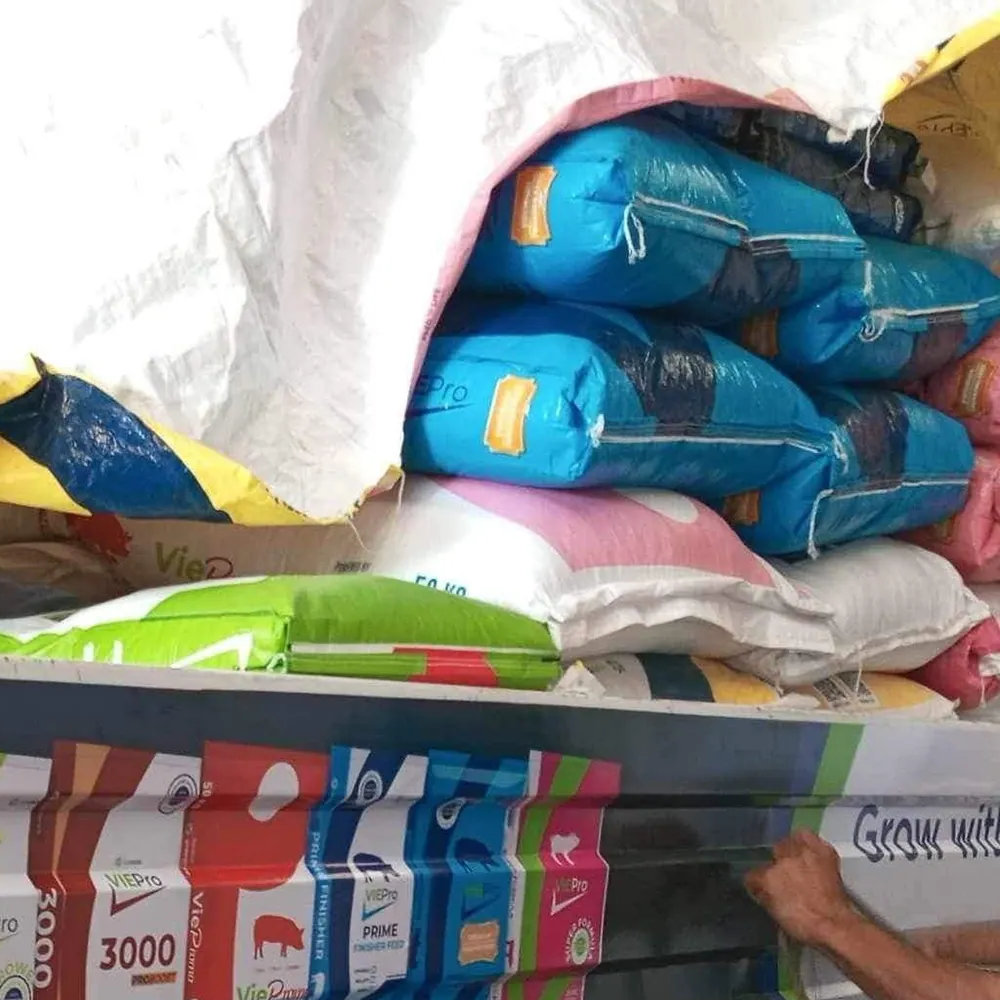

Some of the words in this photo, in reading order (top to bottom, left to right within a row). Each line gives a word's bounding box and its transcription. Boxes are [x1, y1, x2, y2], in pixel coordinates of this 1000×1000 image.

[853, 803, 944, 863] Grow
[104, 872, 163, 888] VIEPro
[34, 888, 58, 989] 3000
[313, 884, 330, 961] FINISHER
[362, 923, 399, 939] PRIME
[99, 933, 177, 971] 3000
